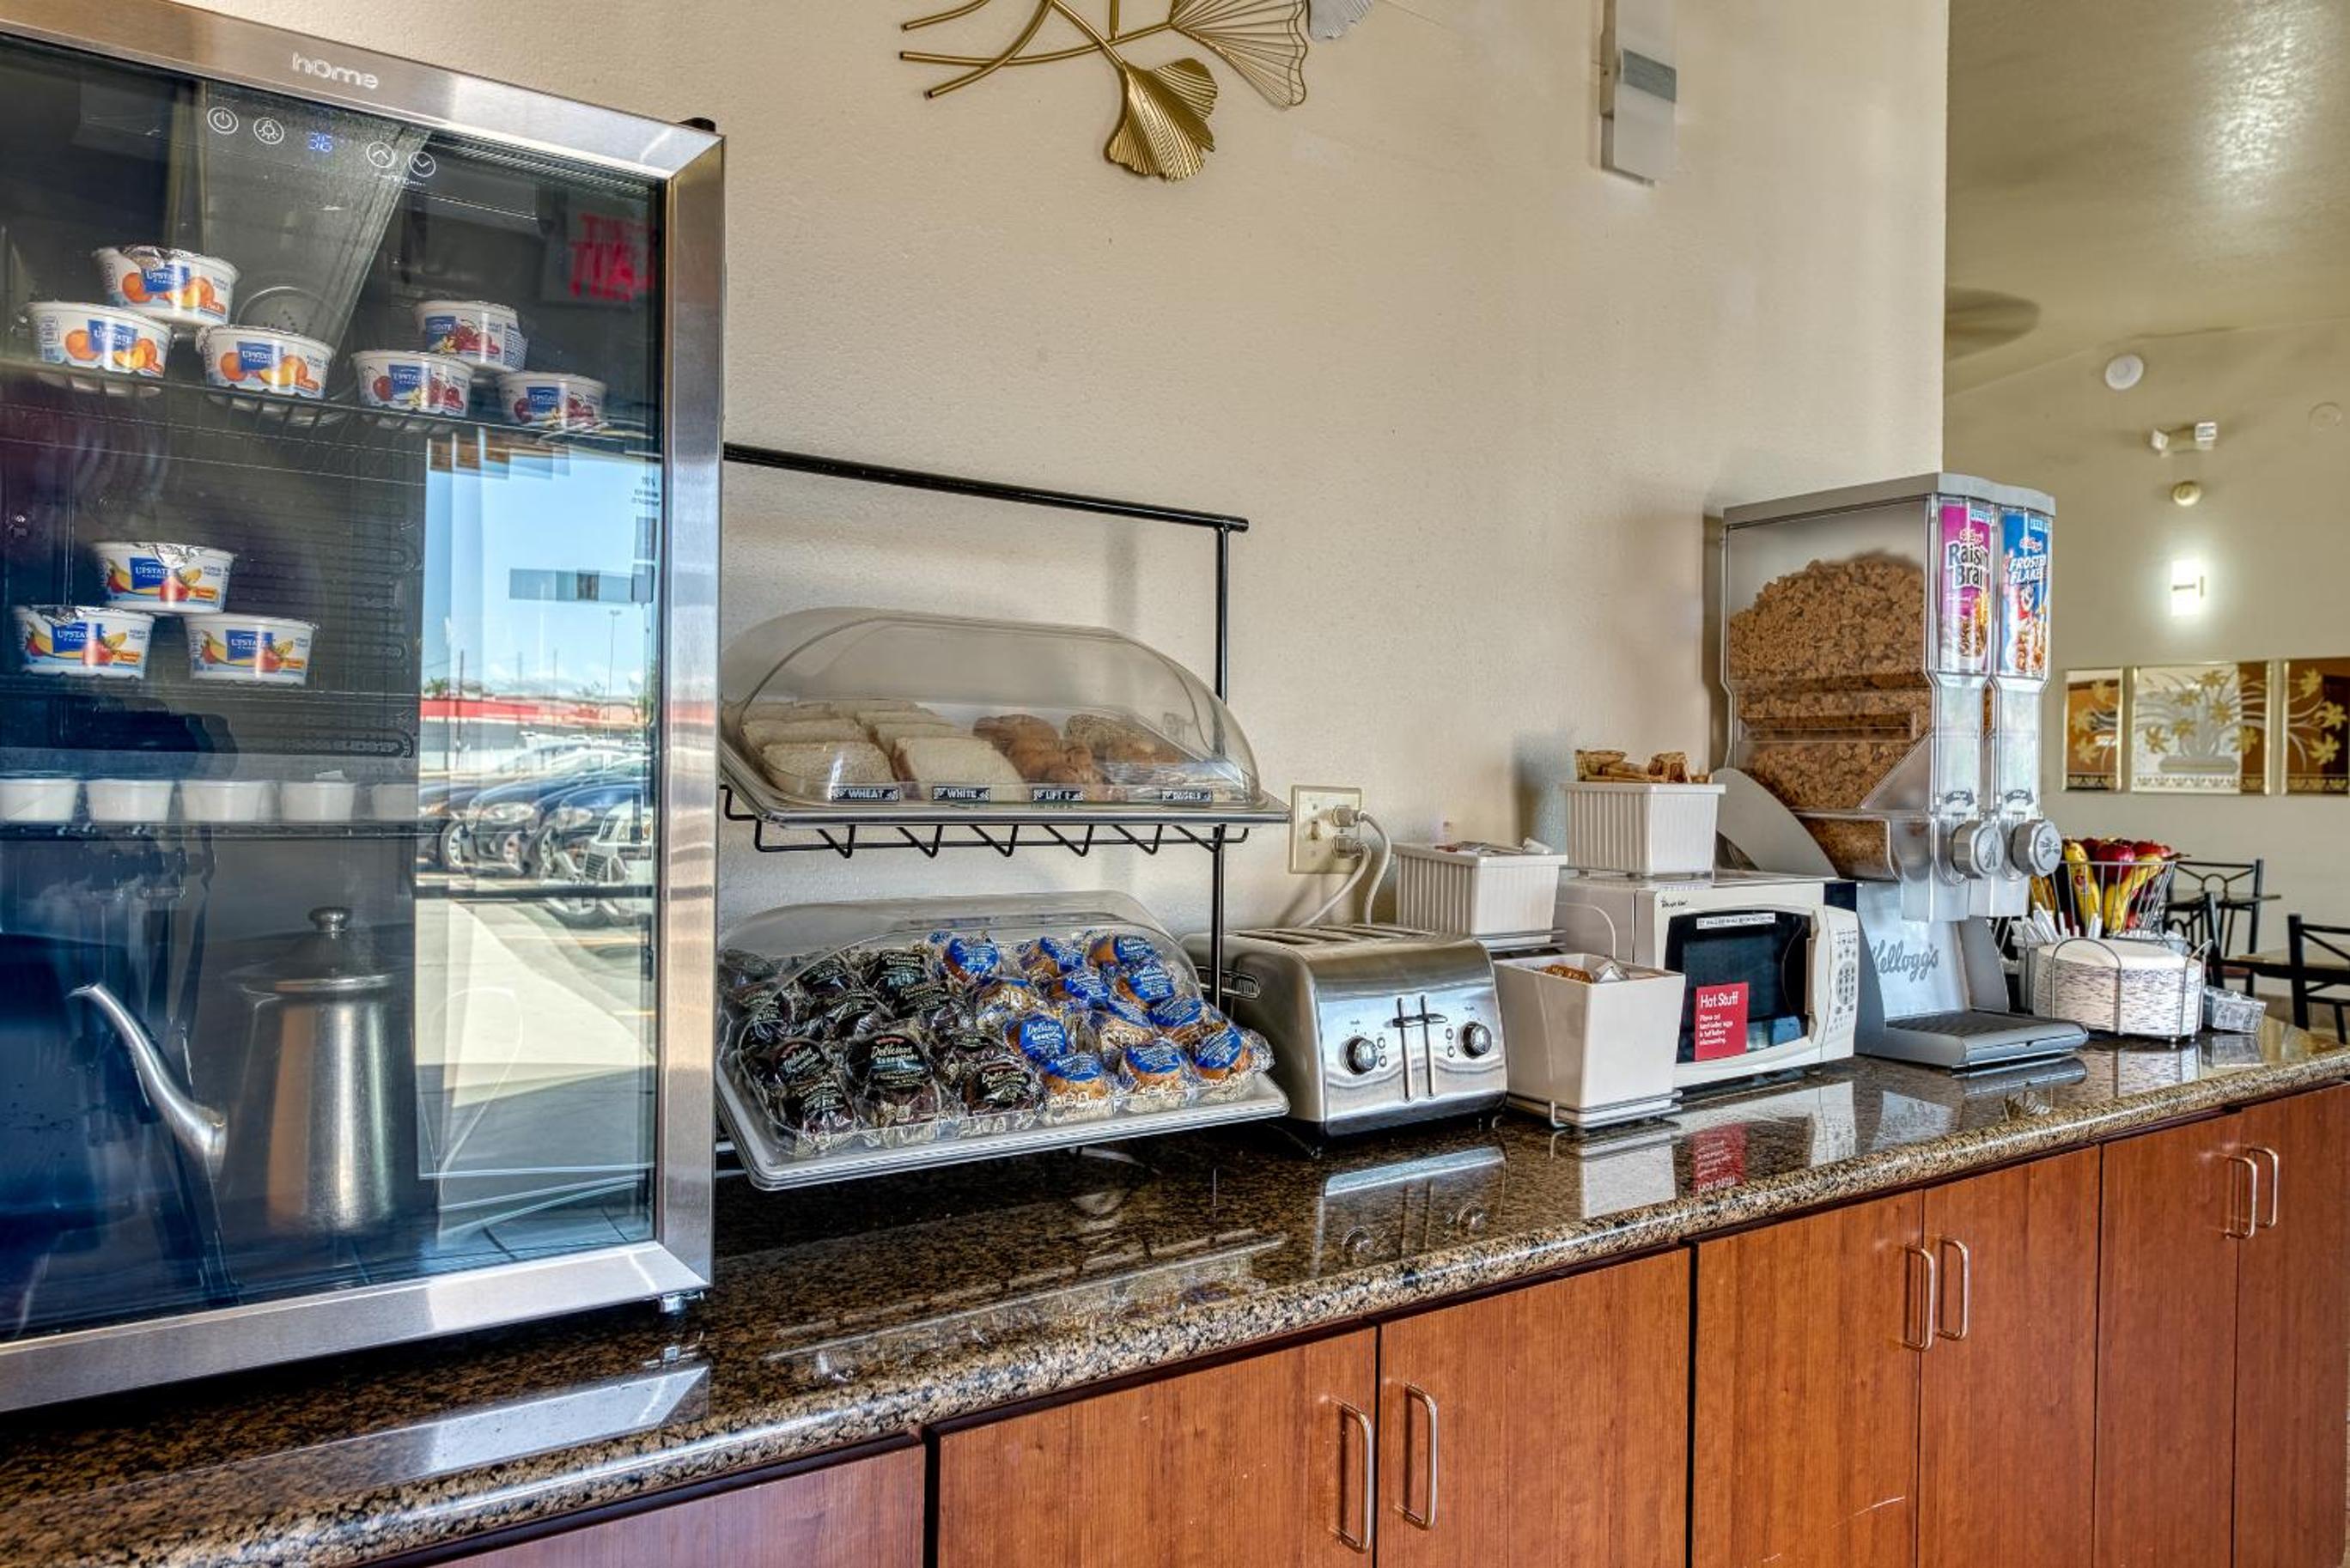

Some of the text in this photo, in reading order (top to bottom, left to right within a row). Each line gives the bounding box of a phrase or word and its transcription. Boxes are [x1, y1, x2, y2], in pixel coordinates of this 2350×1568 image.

[309, 131, 332, 152] 36
[2011, 567, 2046, 584] FLAKE
[849, 789, 885, 799] WHEAT
[947, 788, 977, 799] WHITE
[1701, 991, 1739, 1008] Hot Stuff
[870, 1044, 913, 1060] Delicious
